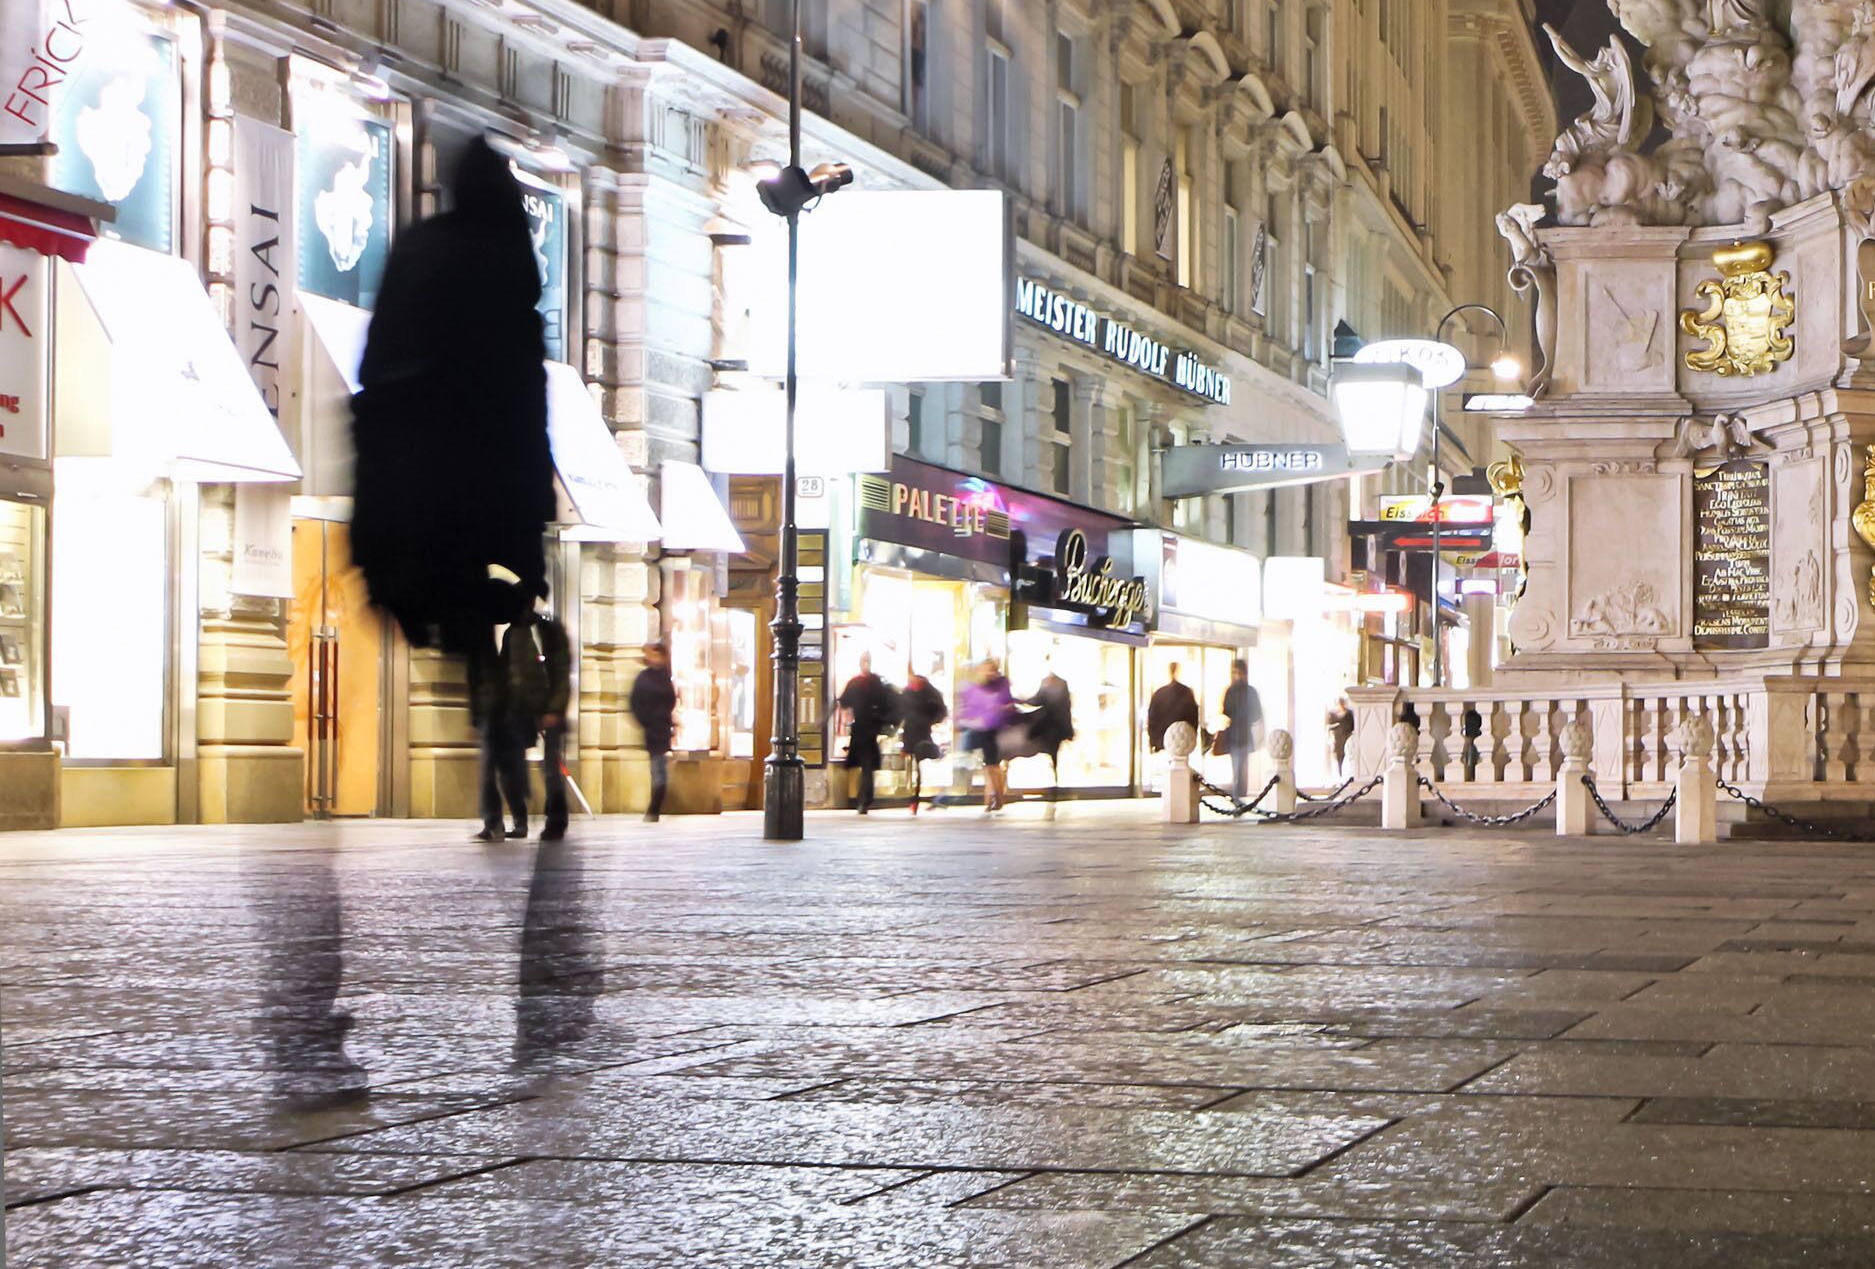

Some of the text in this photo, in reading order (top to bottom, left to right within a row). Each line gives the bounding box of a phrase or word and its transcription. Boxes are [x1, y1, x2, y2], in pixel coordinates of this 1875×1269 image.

[250, 203, 280, 420] ENSAI
[1015, 276, 1232, 406] MEISTER RUDOLF HÜBNER
[892, 483, 984, 533] PALETTE
